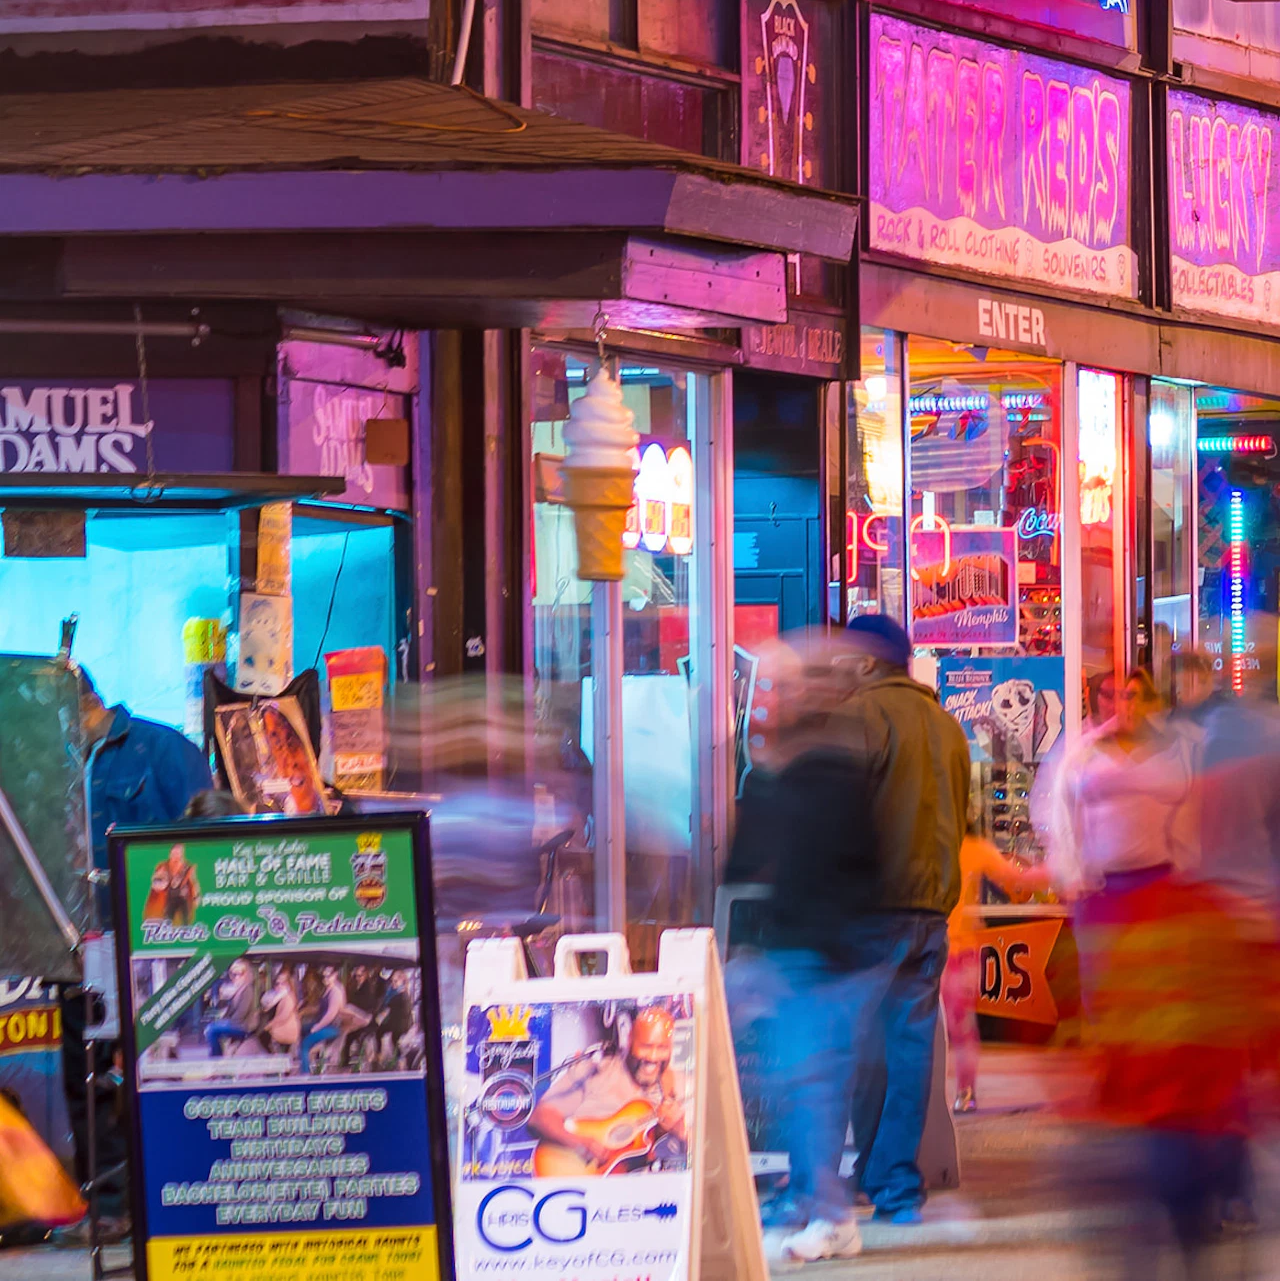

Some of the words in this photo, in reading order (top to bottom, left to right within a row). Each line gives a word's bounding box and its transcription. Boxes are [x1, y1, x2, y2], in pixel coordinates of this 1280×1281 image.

[774, 15, 796, 37] BLACK
[876, 35, 1007, 221] TATER
[1170, 110, 1272, 272] LUCKY
[876, 215, 911, 243] ROCK
[930, 223, 961, 256] ROLL
[964, 230, 1020, 267] CLOTHING
[1172, 265, 1255, 304] COLLECTABLES
[978, 297, 1047, 345] ENTER
[0, 383, 154, 438] MUEL
[953, 608, 1010, 630] Memphis
[943, 688, 977, 712] SNACK
[214, 854, 258, 875] HALL
[261, 854, 283, 872] OF
[286, 851, 332, 871] FAME
[215, 872, 249, 889] BAR
[255, 871, 269, 887] &
[273, 869, 333, 886] GRILLE
[201, 889, 255, 907] PROUD
[254, 887, 325, 905] SPONSOR
[328, 885, 350, 902] OF
[141, 919, 210, 944] River
[213, 914, 265, 944] City
[184, 1091, 307, 1119] CORPORATE
[306, 1088, 388, 1113] EVENTS
[481, 1095, 532, 1112] RESTAURANT
[207, 1117, 265, 1140] TEAM
[266, 1112, 366, 1137] BUILDING
[230, 1134, 346, 1160] BIRTHDAYS
[208, 1153, 371, 1182] ANNIVERSARIES
[161, 1177, 333, 1206] BACHELOR(ETTE)
[334, 1171, 421, 1197] PARTIES
[216, 1199, 323, 1225] EVERYDAY
[323, 1197, 368, 1221] FUN
